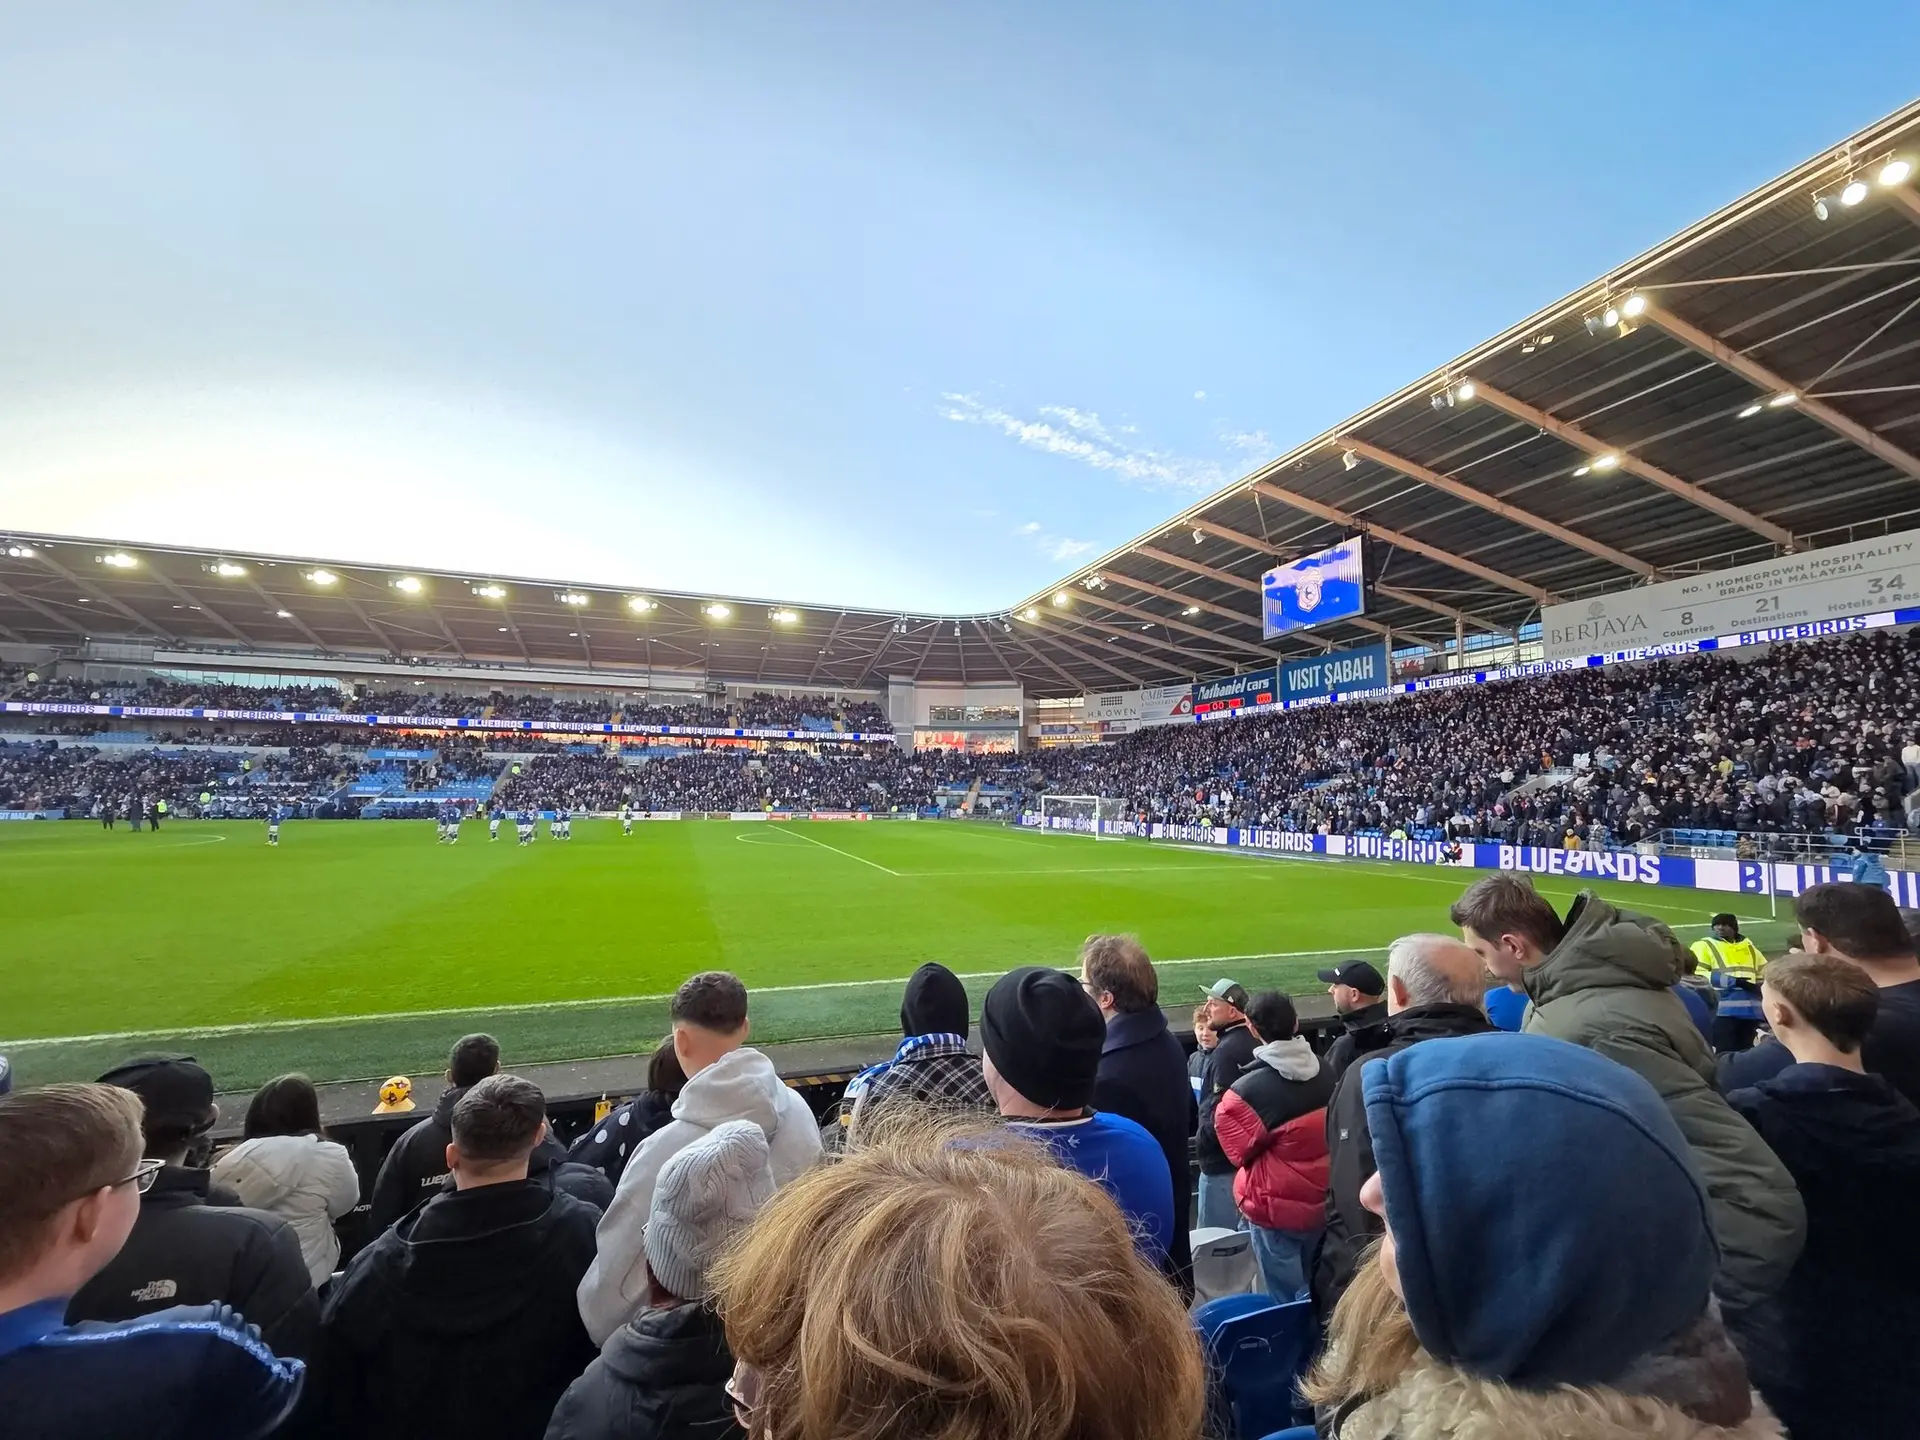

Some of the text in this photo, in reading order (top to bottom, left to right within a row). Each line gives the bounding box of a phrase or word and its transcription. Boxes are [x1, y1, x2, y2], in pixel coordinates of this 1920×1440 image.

[1682, 586, 1702, 595] NO.
[1716, 564, 1805, 588] HOMEGROWN
[1810, 542, 1914, 570] HOSPITALITY
[1719, 563, 1864, 596] BRAND IN MALAYSIA
[1867, 573, 1907, 594] 34
[1755, 596, 1779, 613] 21
[1828, 598, 1873, 612] Hotels
[1878, 595, 1888, 604] &
[1680, 611, 1694, 625] 8
[1731, 609, 1808, 628] Destinations
[1551, 614, 1648, 645] BERJAYA
[1662, 624, 1716, 638] Countries
[1740, 615, 1867, 645] BLUEBIRDS
[1603, 636, 1649, 649] RESORTS
[1603, 640, 1700, 665] BLUEBIRDS
[1288, 655, 1374, 692] VISIT SABAH
[1499, 659, 1573, 680] BLUEBIRDS
[1197, 677, 1247, 701] Nathaniel
[1246, 678, 1270, 692] cars
[1415, 673, 1476, 690] BLUEBIRDS
[1289, 695, 1331, 709] BLUEBIRDS
[1347, 686, 1396, 701] BLUEBIRDS
[21, 702, 95, 713] BLUEBIRDS
[122, 706, 193, 717] BLUEBIRDS
[218, 710, 283, 720] BLUEBIRDS
[1201, 709, 1232, 721] BLUEBIRDS
[305, 712, 367, 723] BLUEBIRDS
[388, 716, 447, 726] BLUEBIRDS
[467, 719, 523, 728] BLUEBIRDS
[1162, 823, 1215, 842] BLUEBIRDS
[1239, 829, 1314, 852] BLUEBIRDS
[1499, 845, 1660, 884] BLUEBIRDS
[67, 1330, 129, 1342] balance
